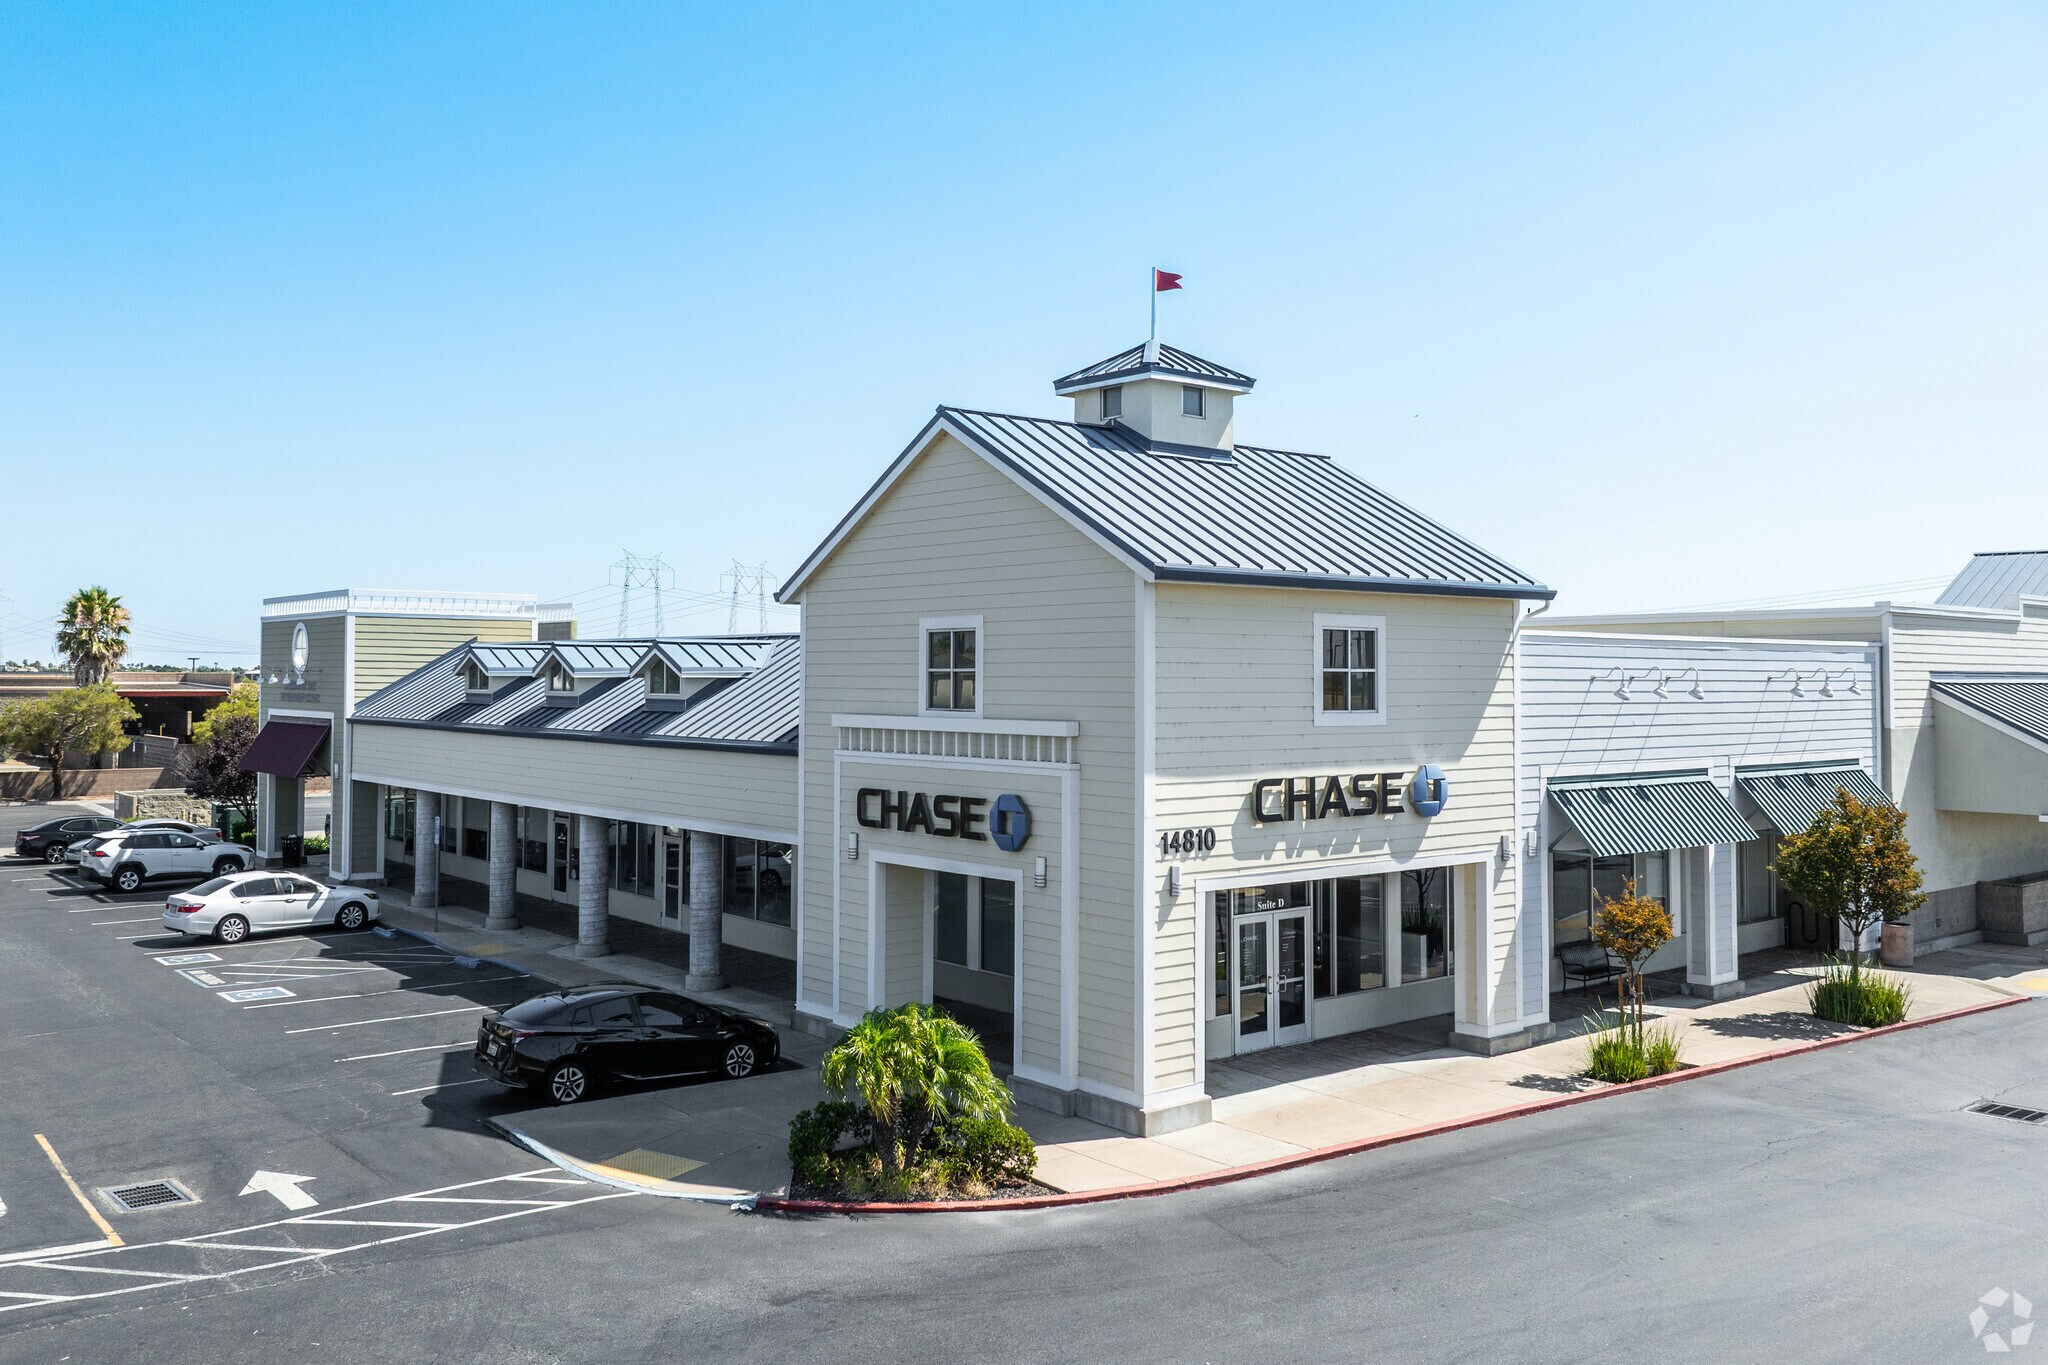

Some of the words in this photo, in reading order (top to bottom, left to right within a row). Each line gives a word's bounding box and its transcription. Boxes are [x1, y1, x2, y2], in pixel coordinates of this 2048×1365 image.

[857, 788, 987, 841] CHASE
[1252, 772, 1405, 823] CHASE
[1160, 827, 1216, 855] 14810
[1257, 900, 1276, 911] Suite
[1278, 898, 1285, 908] D
